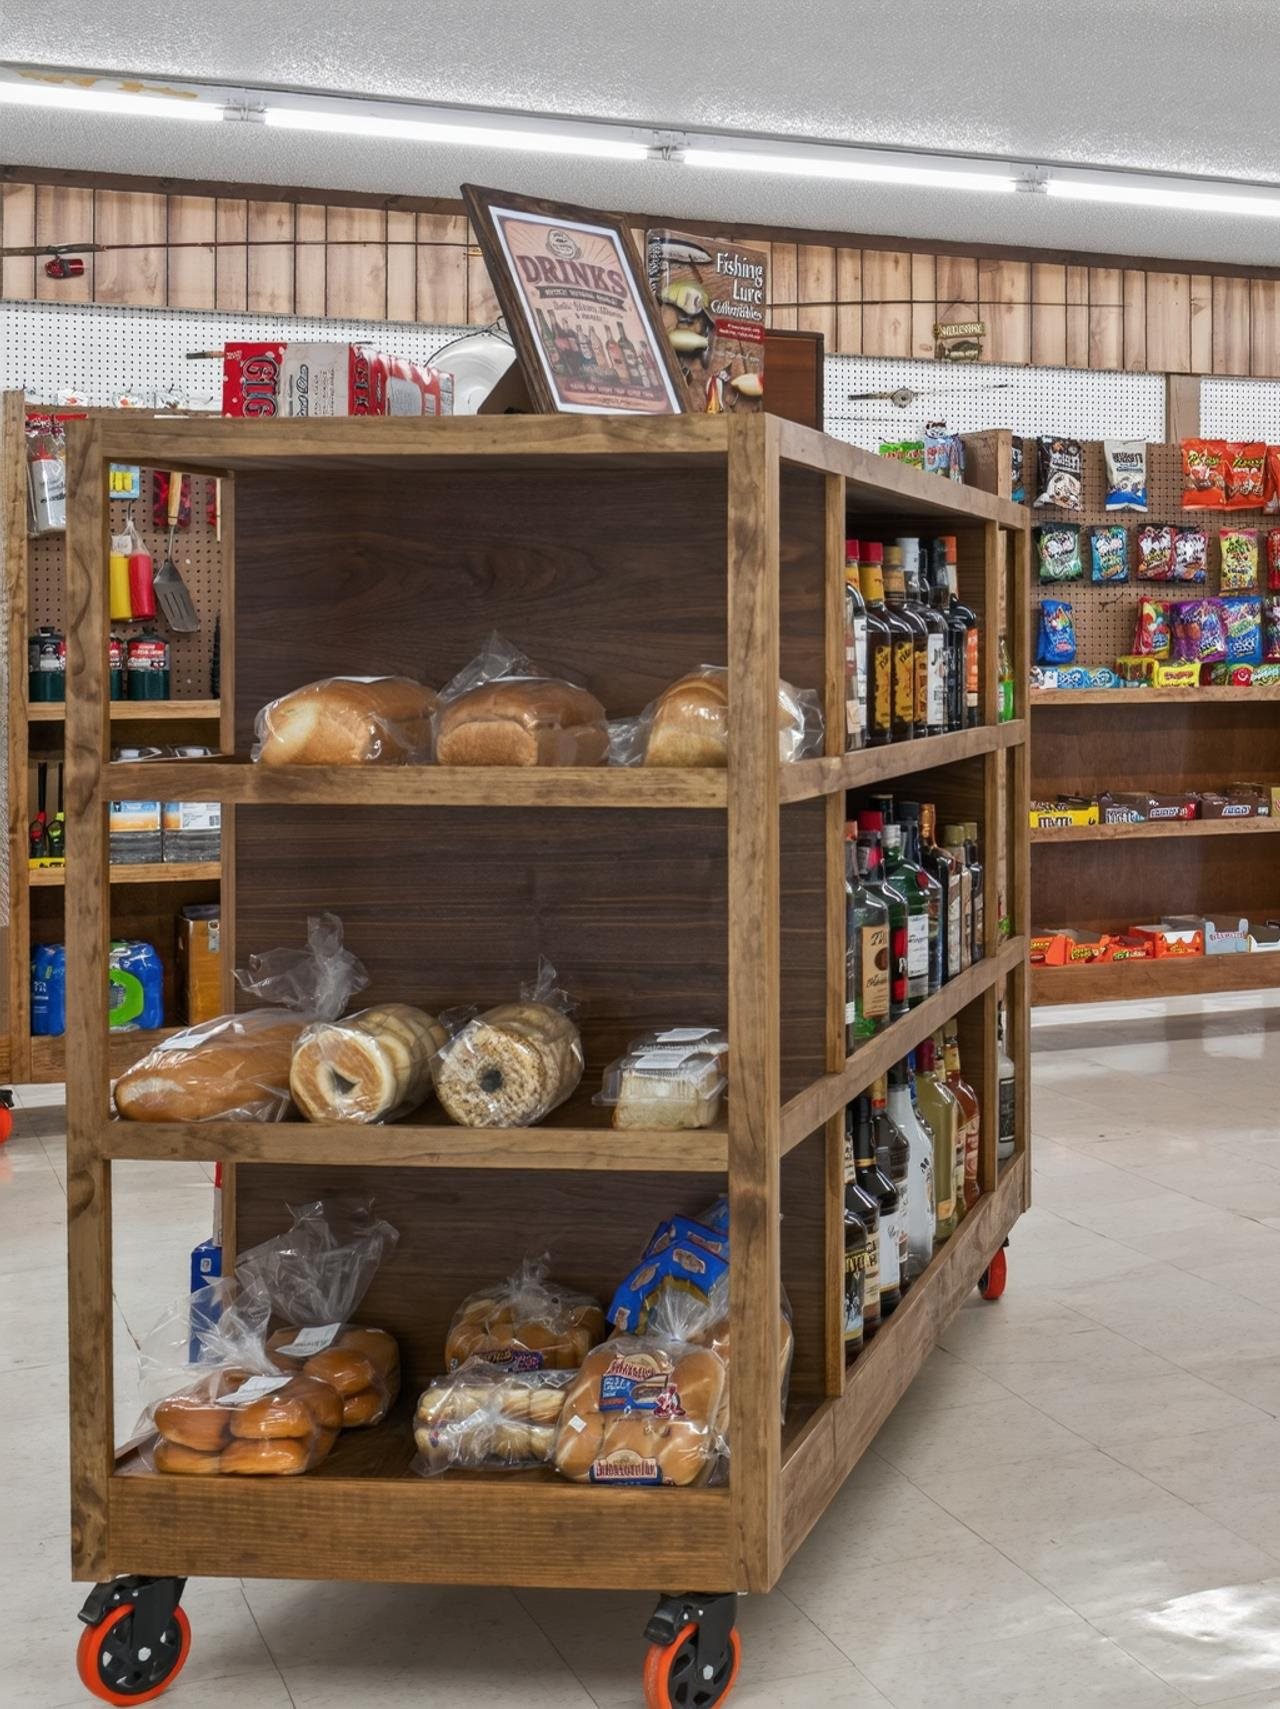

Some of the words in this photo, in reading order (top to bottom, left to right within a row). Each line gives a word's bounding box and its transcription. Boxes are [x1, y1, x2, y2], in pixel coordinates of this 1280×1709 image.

[516, 255, 628, 298] DRINKS
[716, 252, 763, 287] Fishing
[733, 279, 763, 304] Lure
